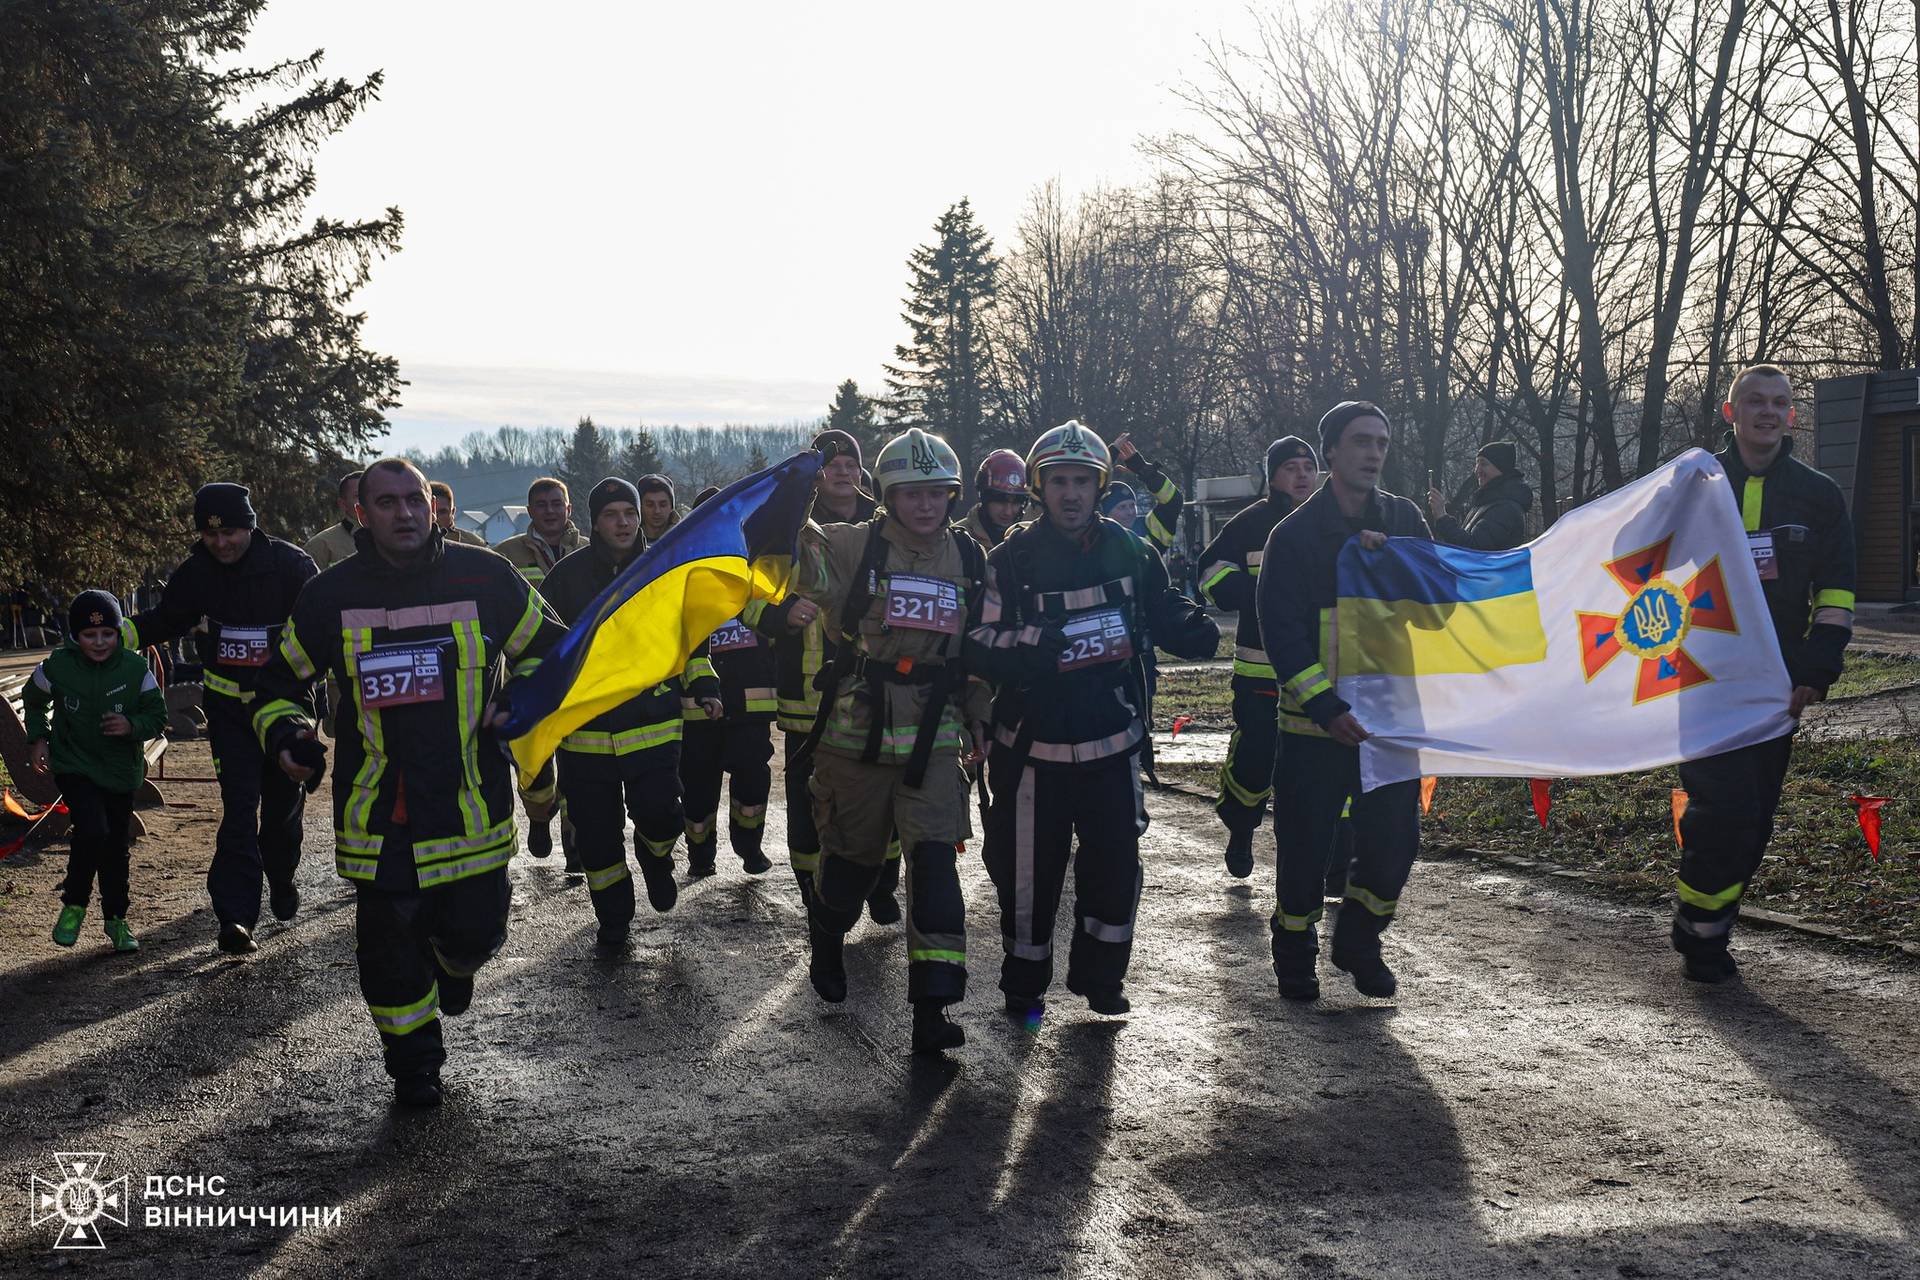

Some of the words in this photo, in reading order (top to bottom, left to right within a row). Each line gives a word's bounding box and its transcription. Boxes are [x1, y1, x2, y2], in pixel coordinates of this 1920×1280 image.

[890, 596, 935, 621] 321
[711, 629, 740, 647] 324
[219, 642, 248, 659] 363
[1060, 635, 1105, 663] 325
[364, 671, 412, 699] 337
[114, 703, 123, 713] 18
